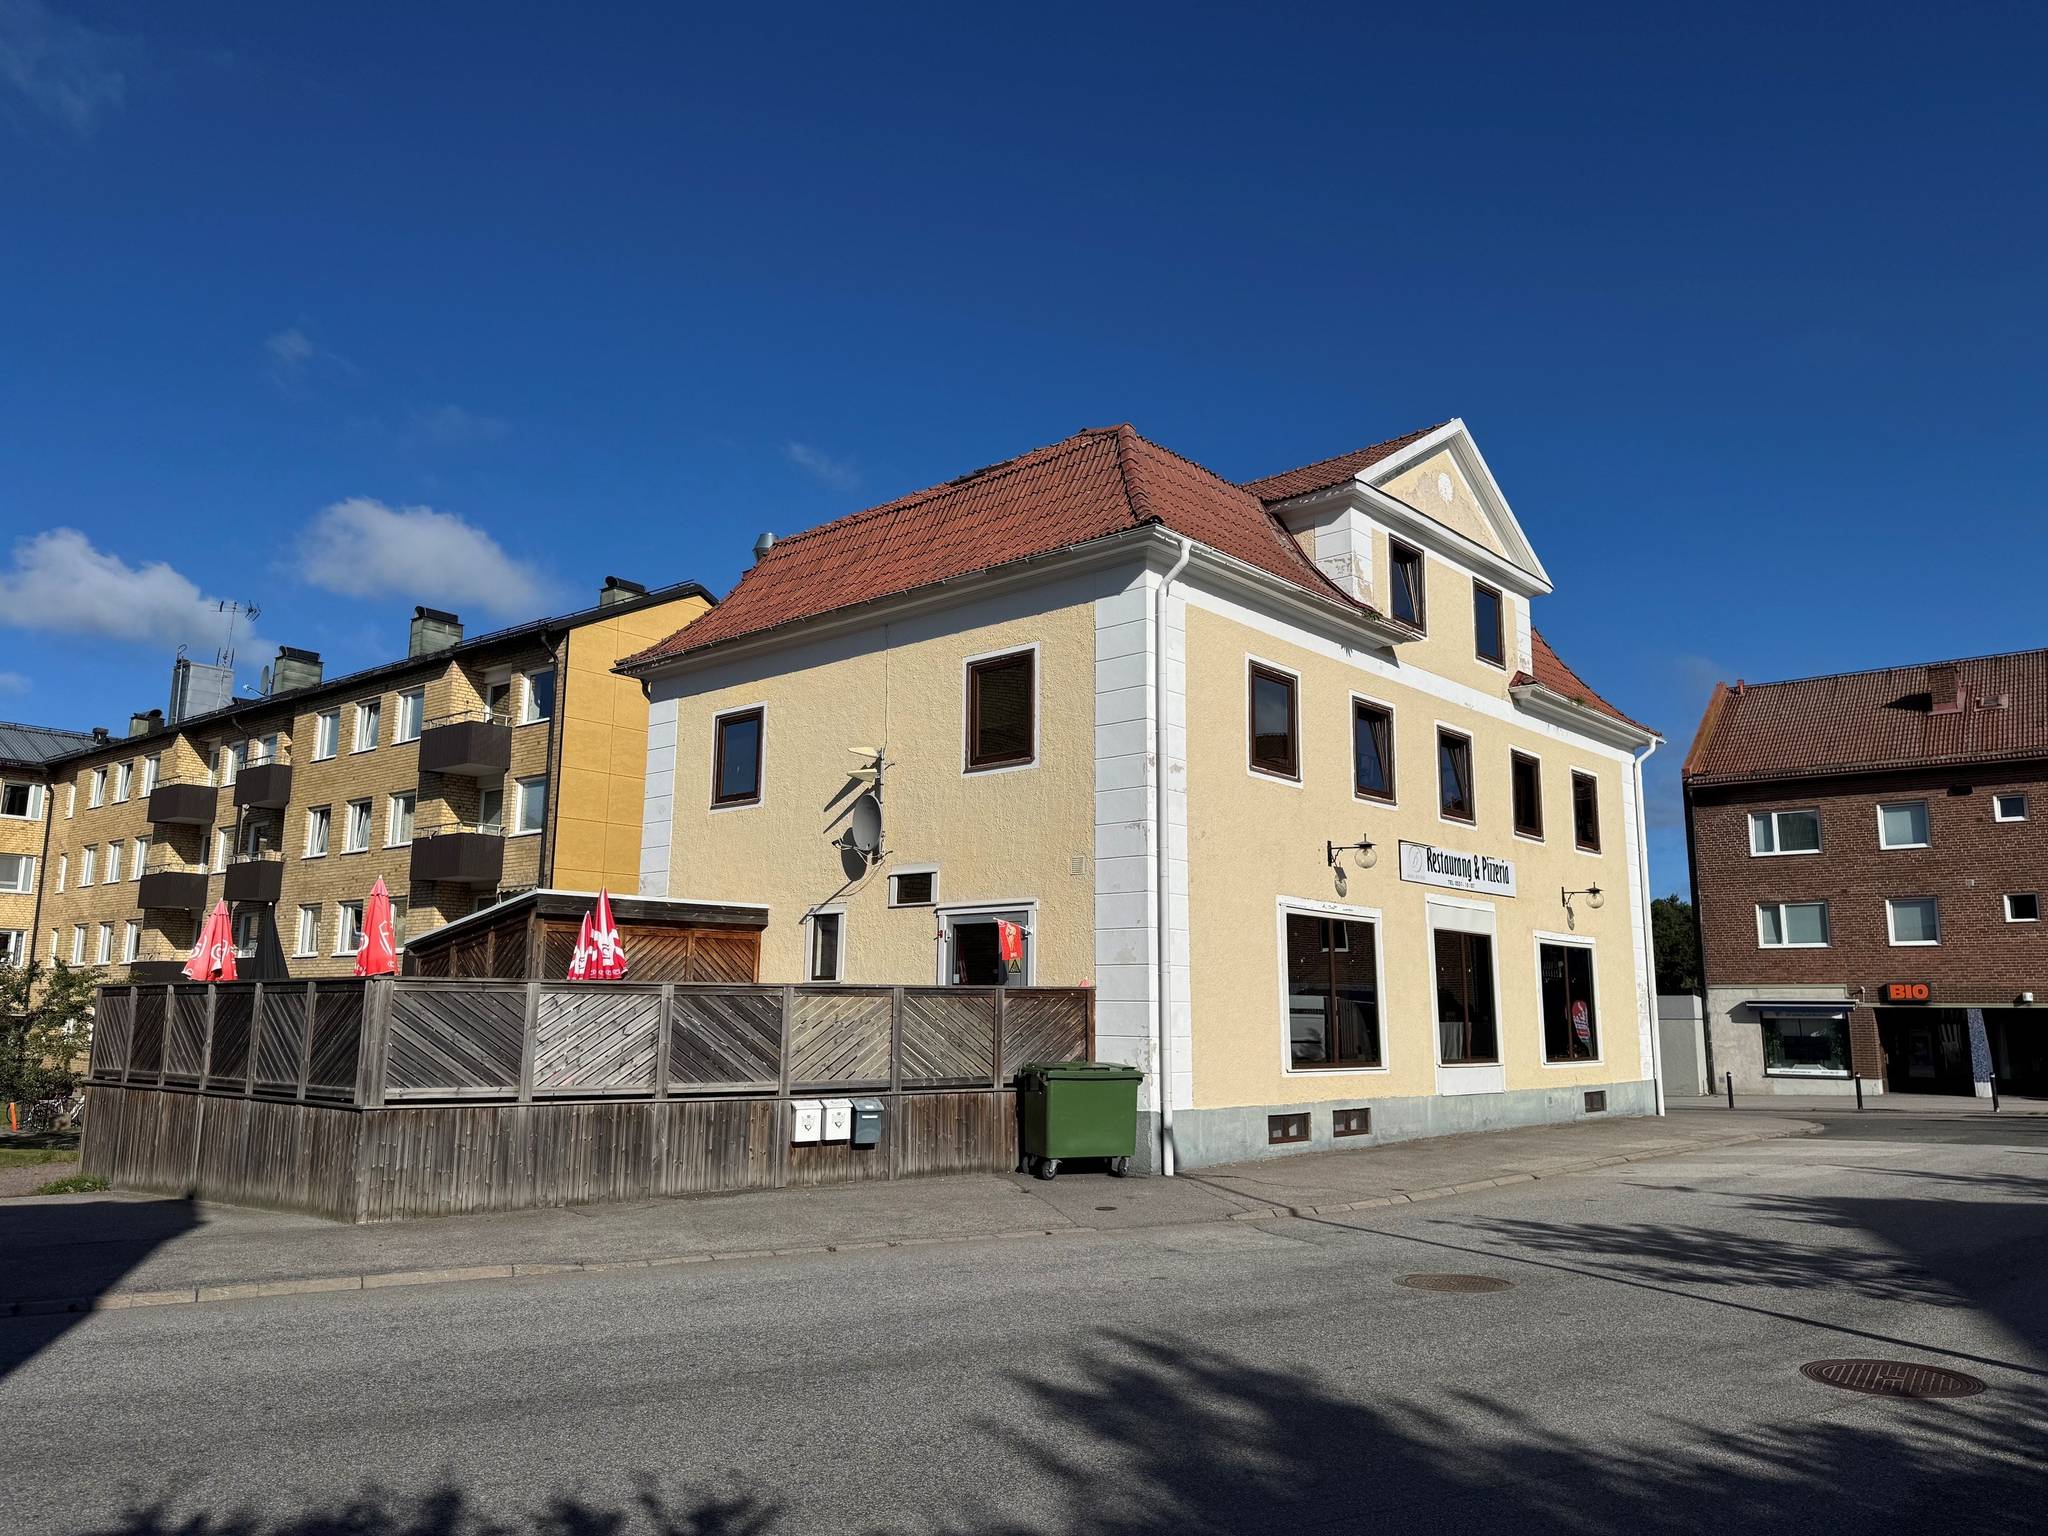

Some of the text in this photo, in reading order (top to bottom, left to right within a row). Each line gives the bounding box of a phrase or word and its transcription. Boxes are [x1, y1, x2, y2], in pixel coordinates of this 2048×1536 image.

[1426, 847, 1510, 884] Restaurang & Pizzeria
[1889, 983, 1929, 1000] BIO
